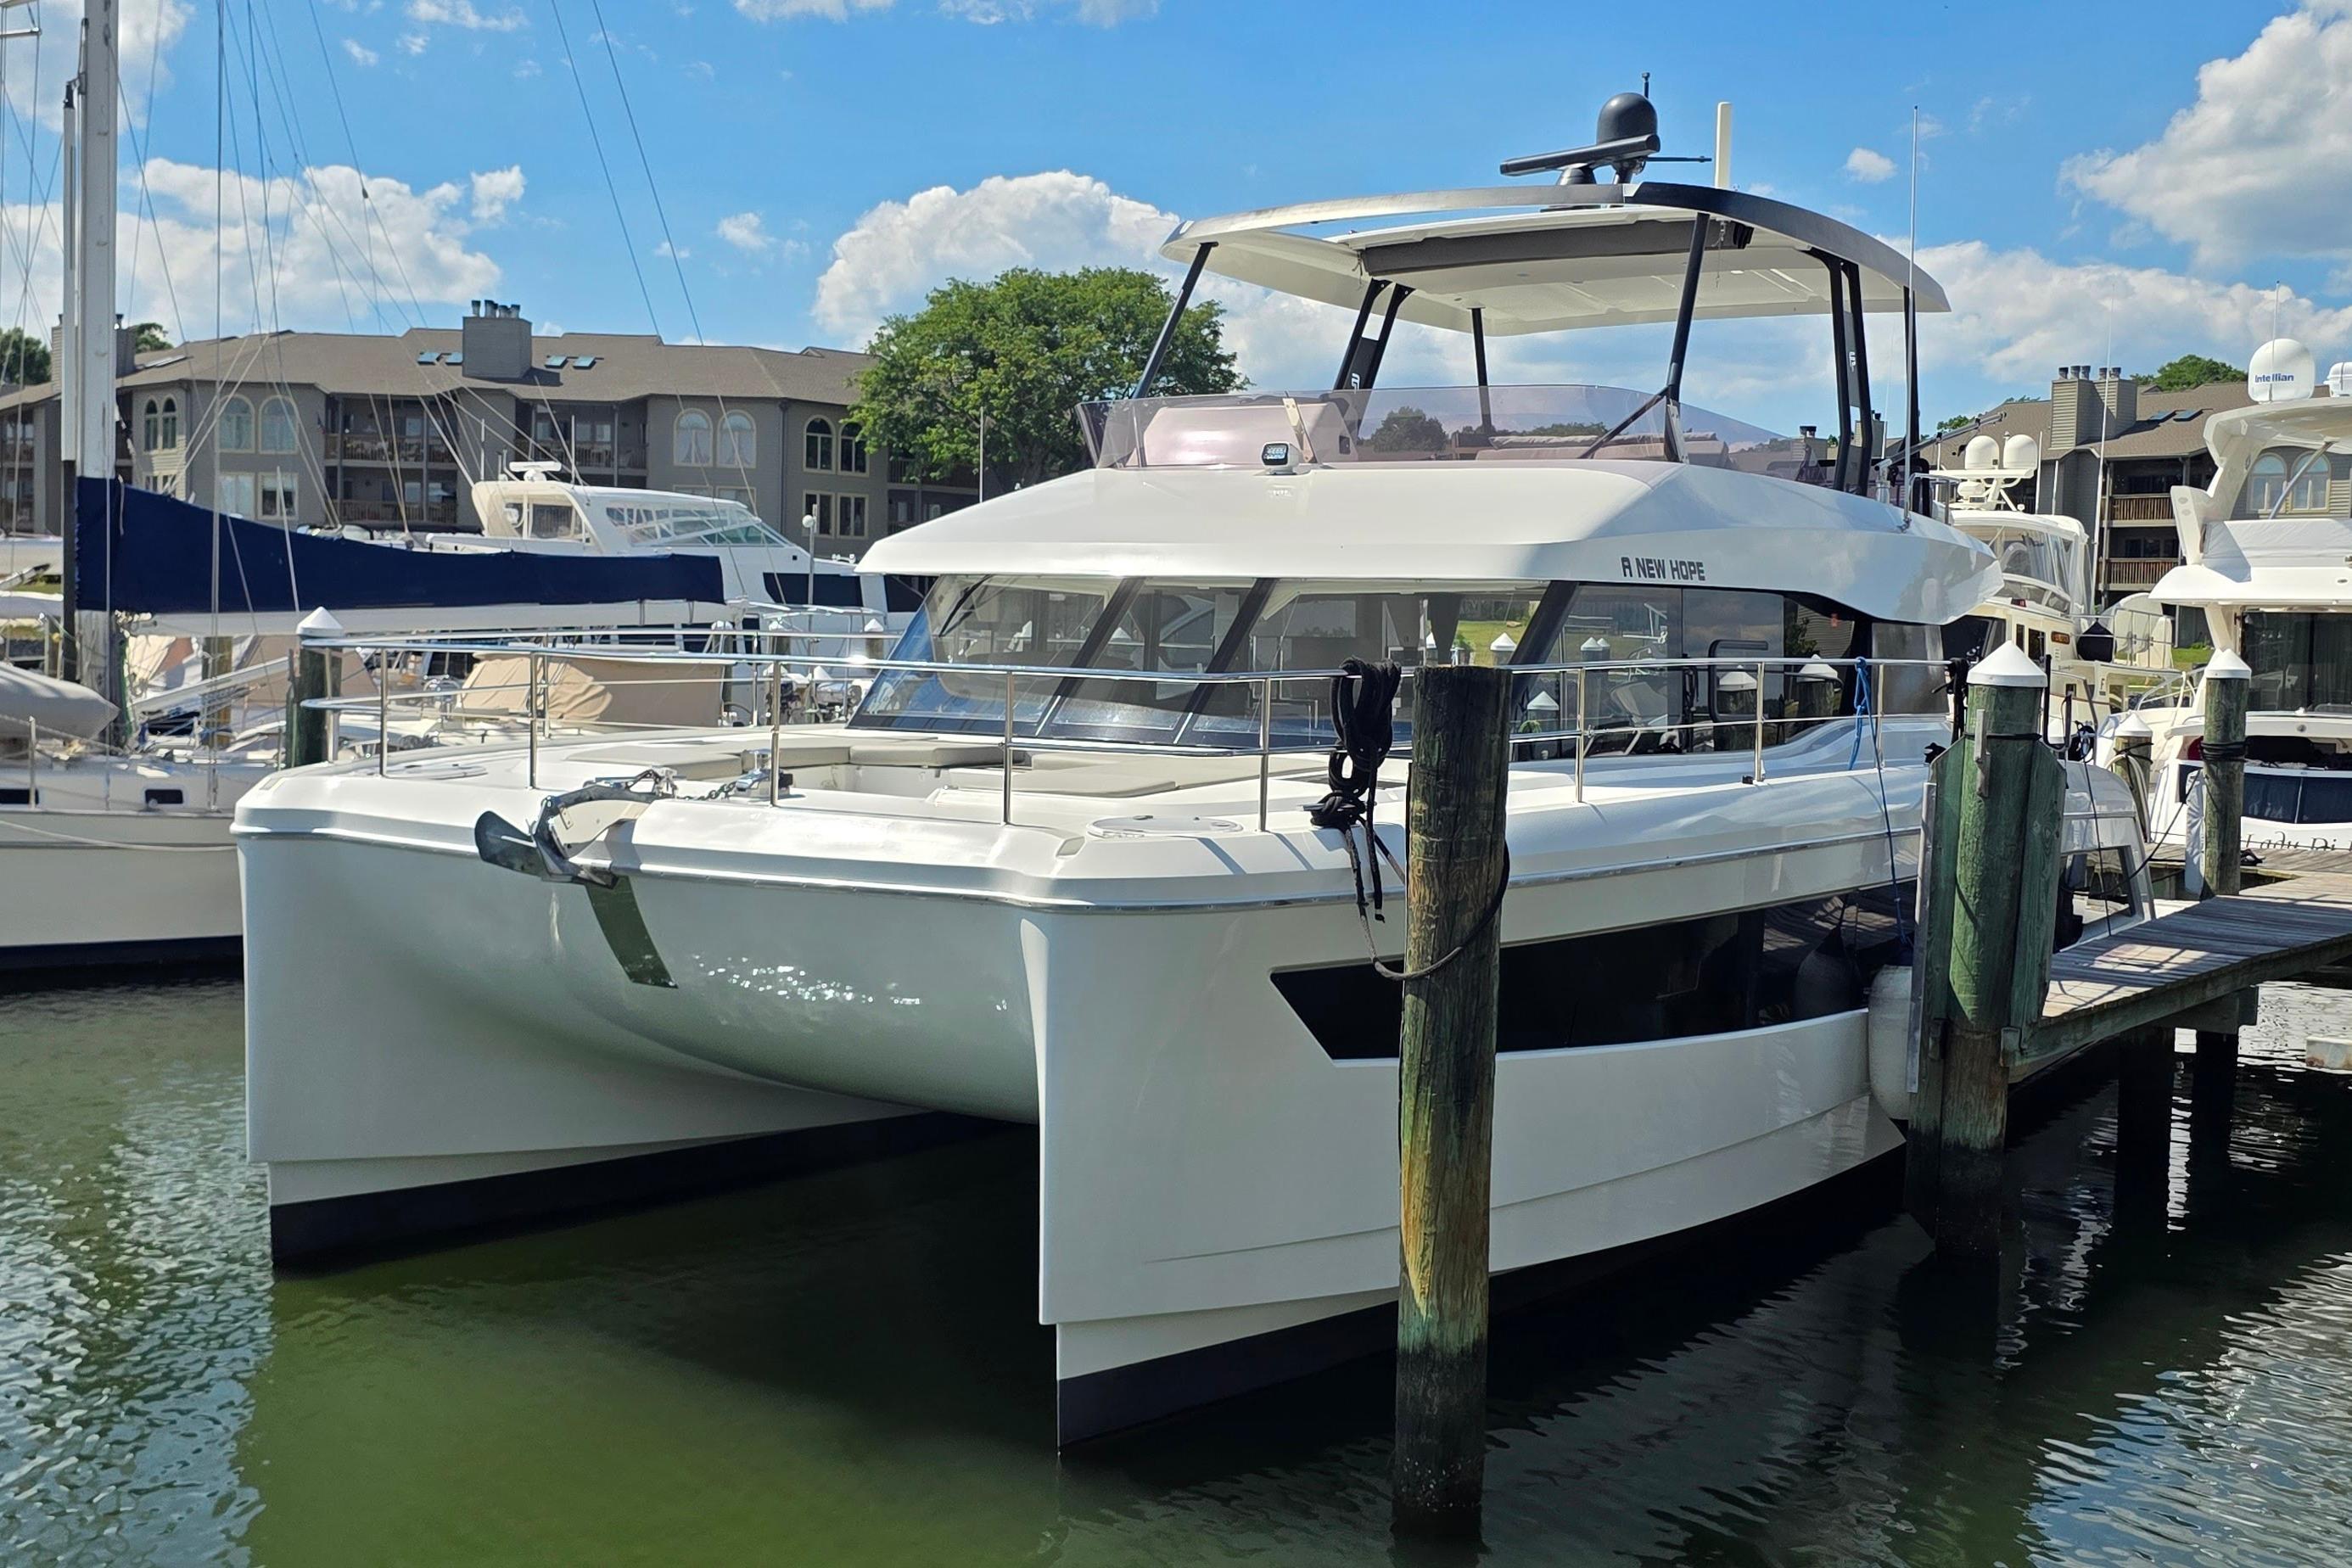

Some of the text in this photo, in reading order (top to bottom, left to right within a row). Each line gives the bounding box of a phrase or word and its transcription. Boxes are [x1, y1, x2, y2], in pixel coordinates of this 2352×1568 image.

[2254, 373, 2294, 383] Intellian
[1621, 557, 1705, 581] A NEW HOPE
